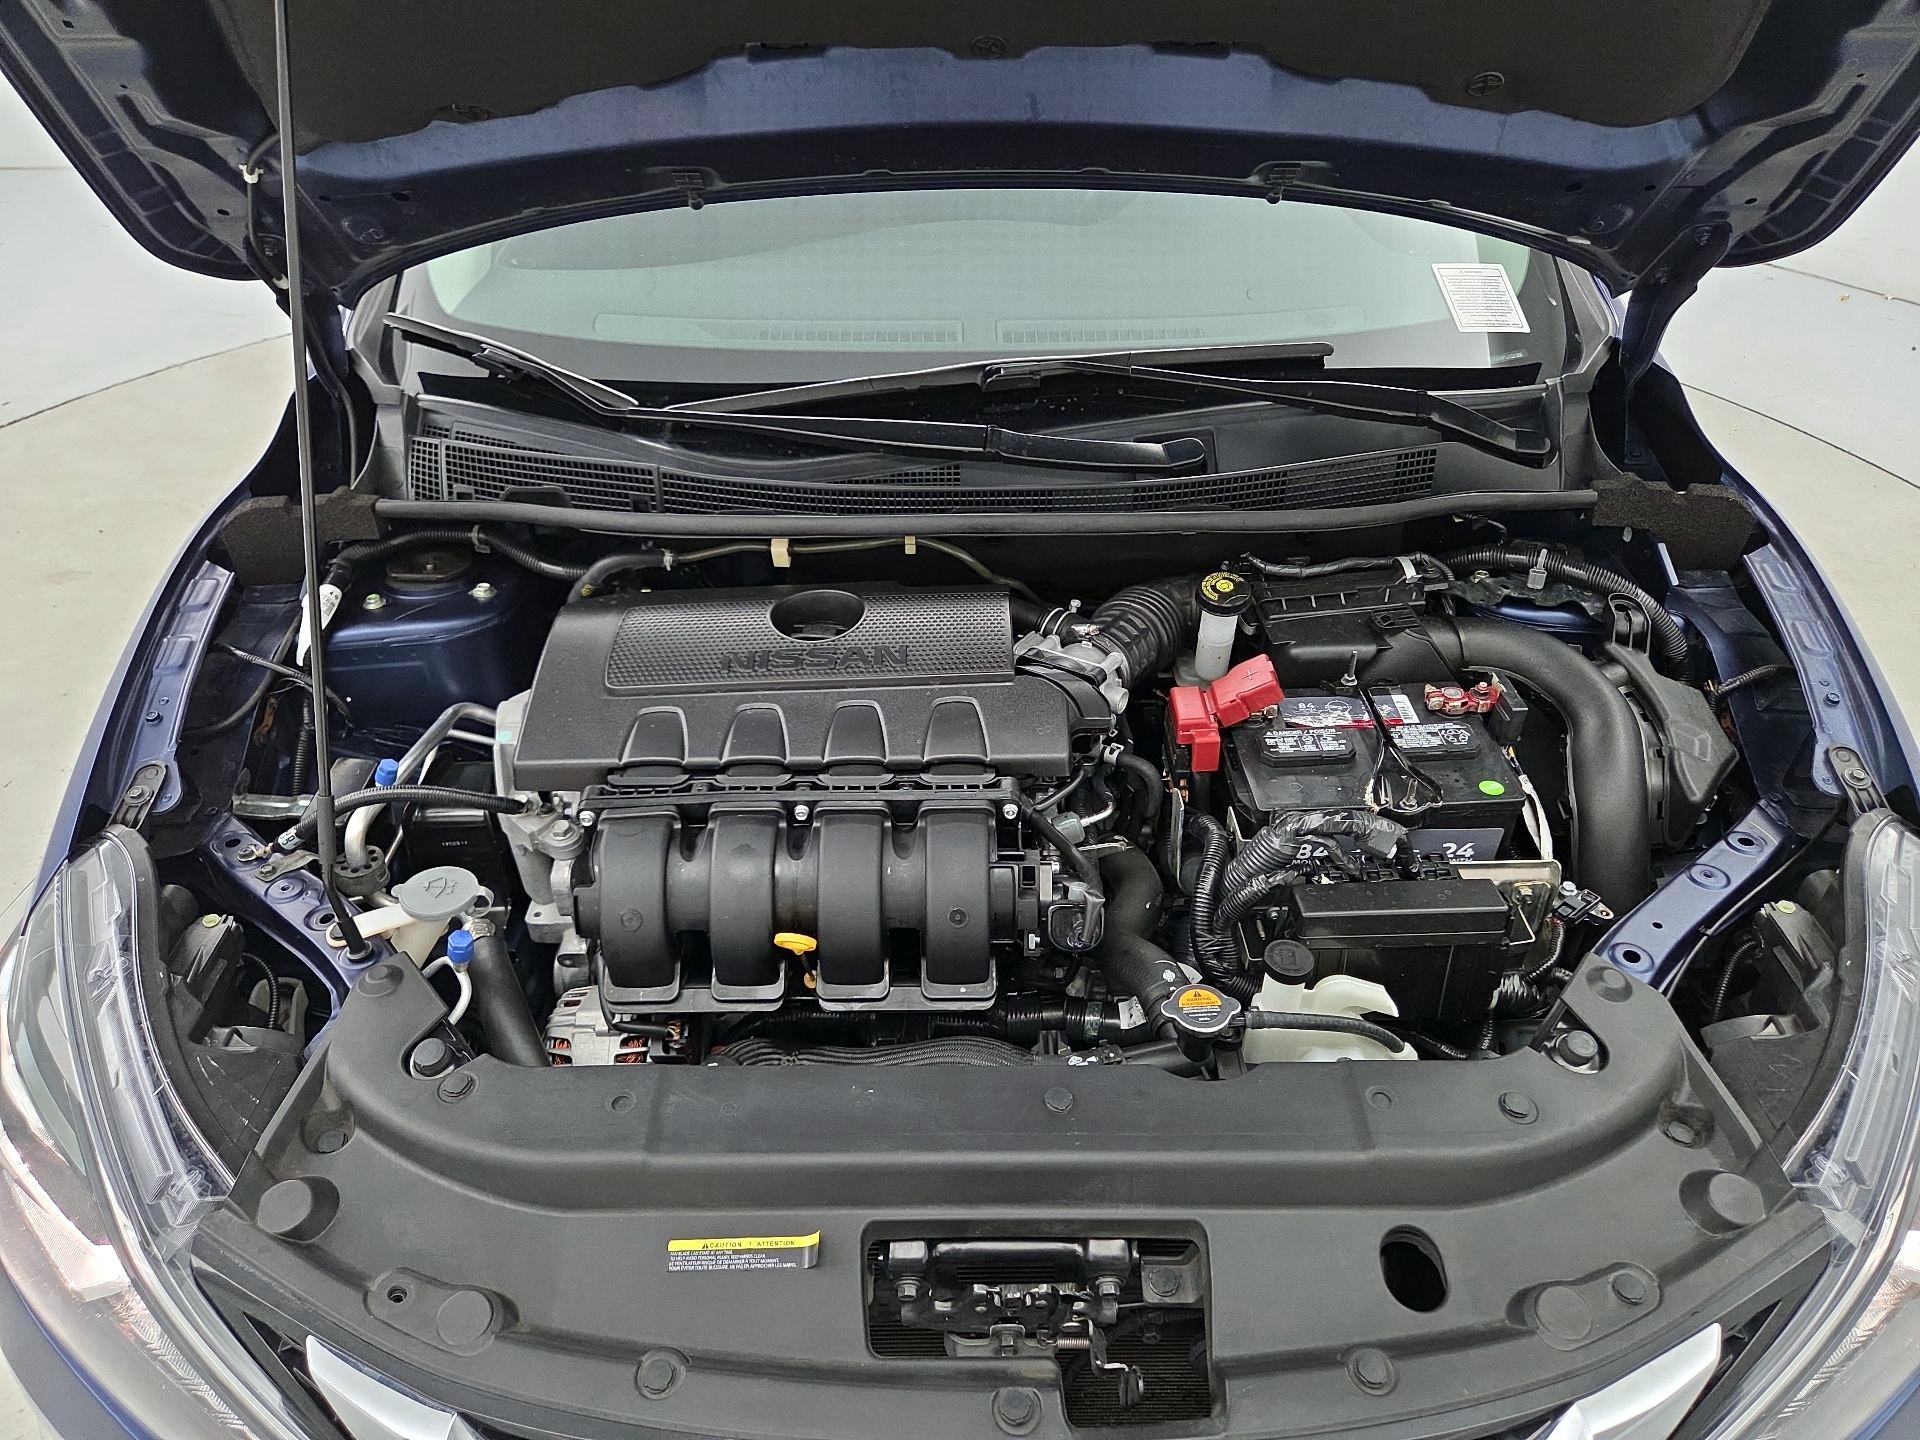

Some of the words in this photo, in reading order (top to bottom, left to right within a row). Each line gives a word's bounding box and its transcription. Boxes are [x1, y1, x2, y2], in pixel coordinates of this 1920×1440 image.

[722, 645, 909, 674] NISSAN
[1296, 843, 1329, 859] 84
[1442, 842, 1476, 858] 24
